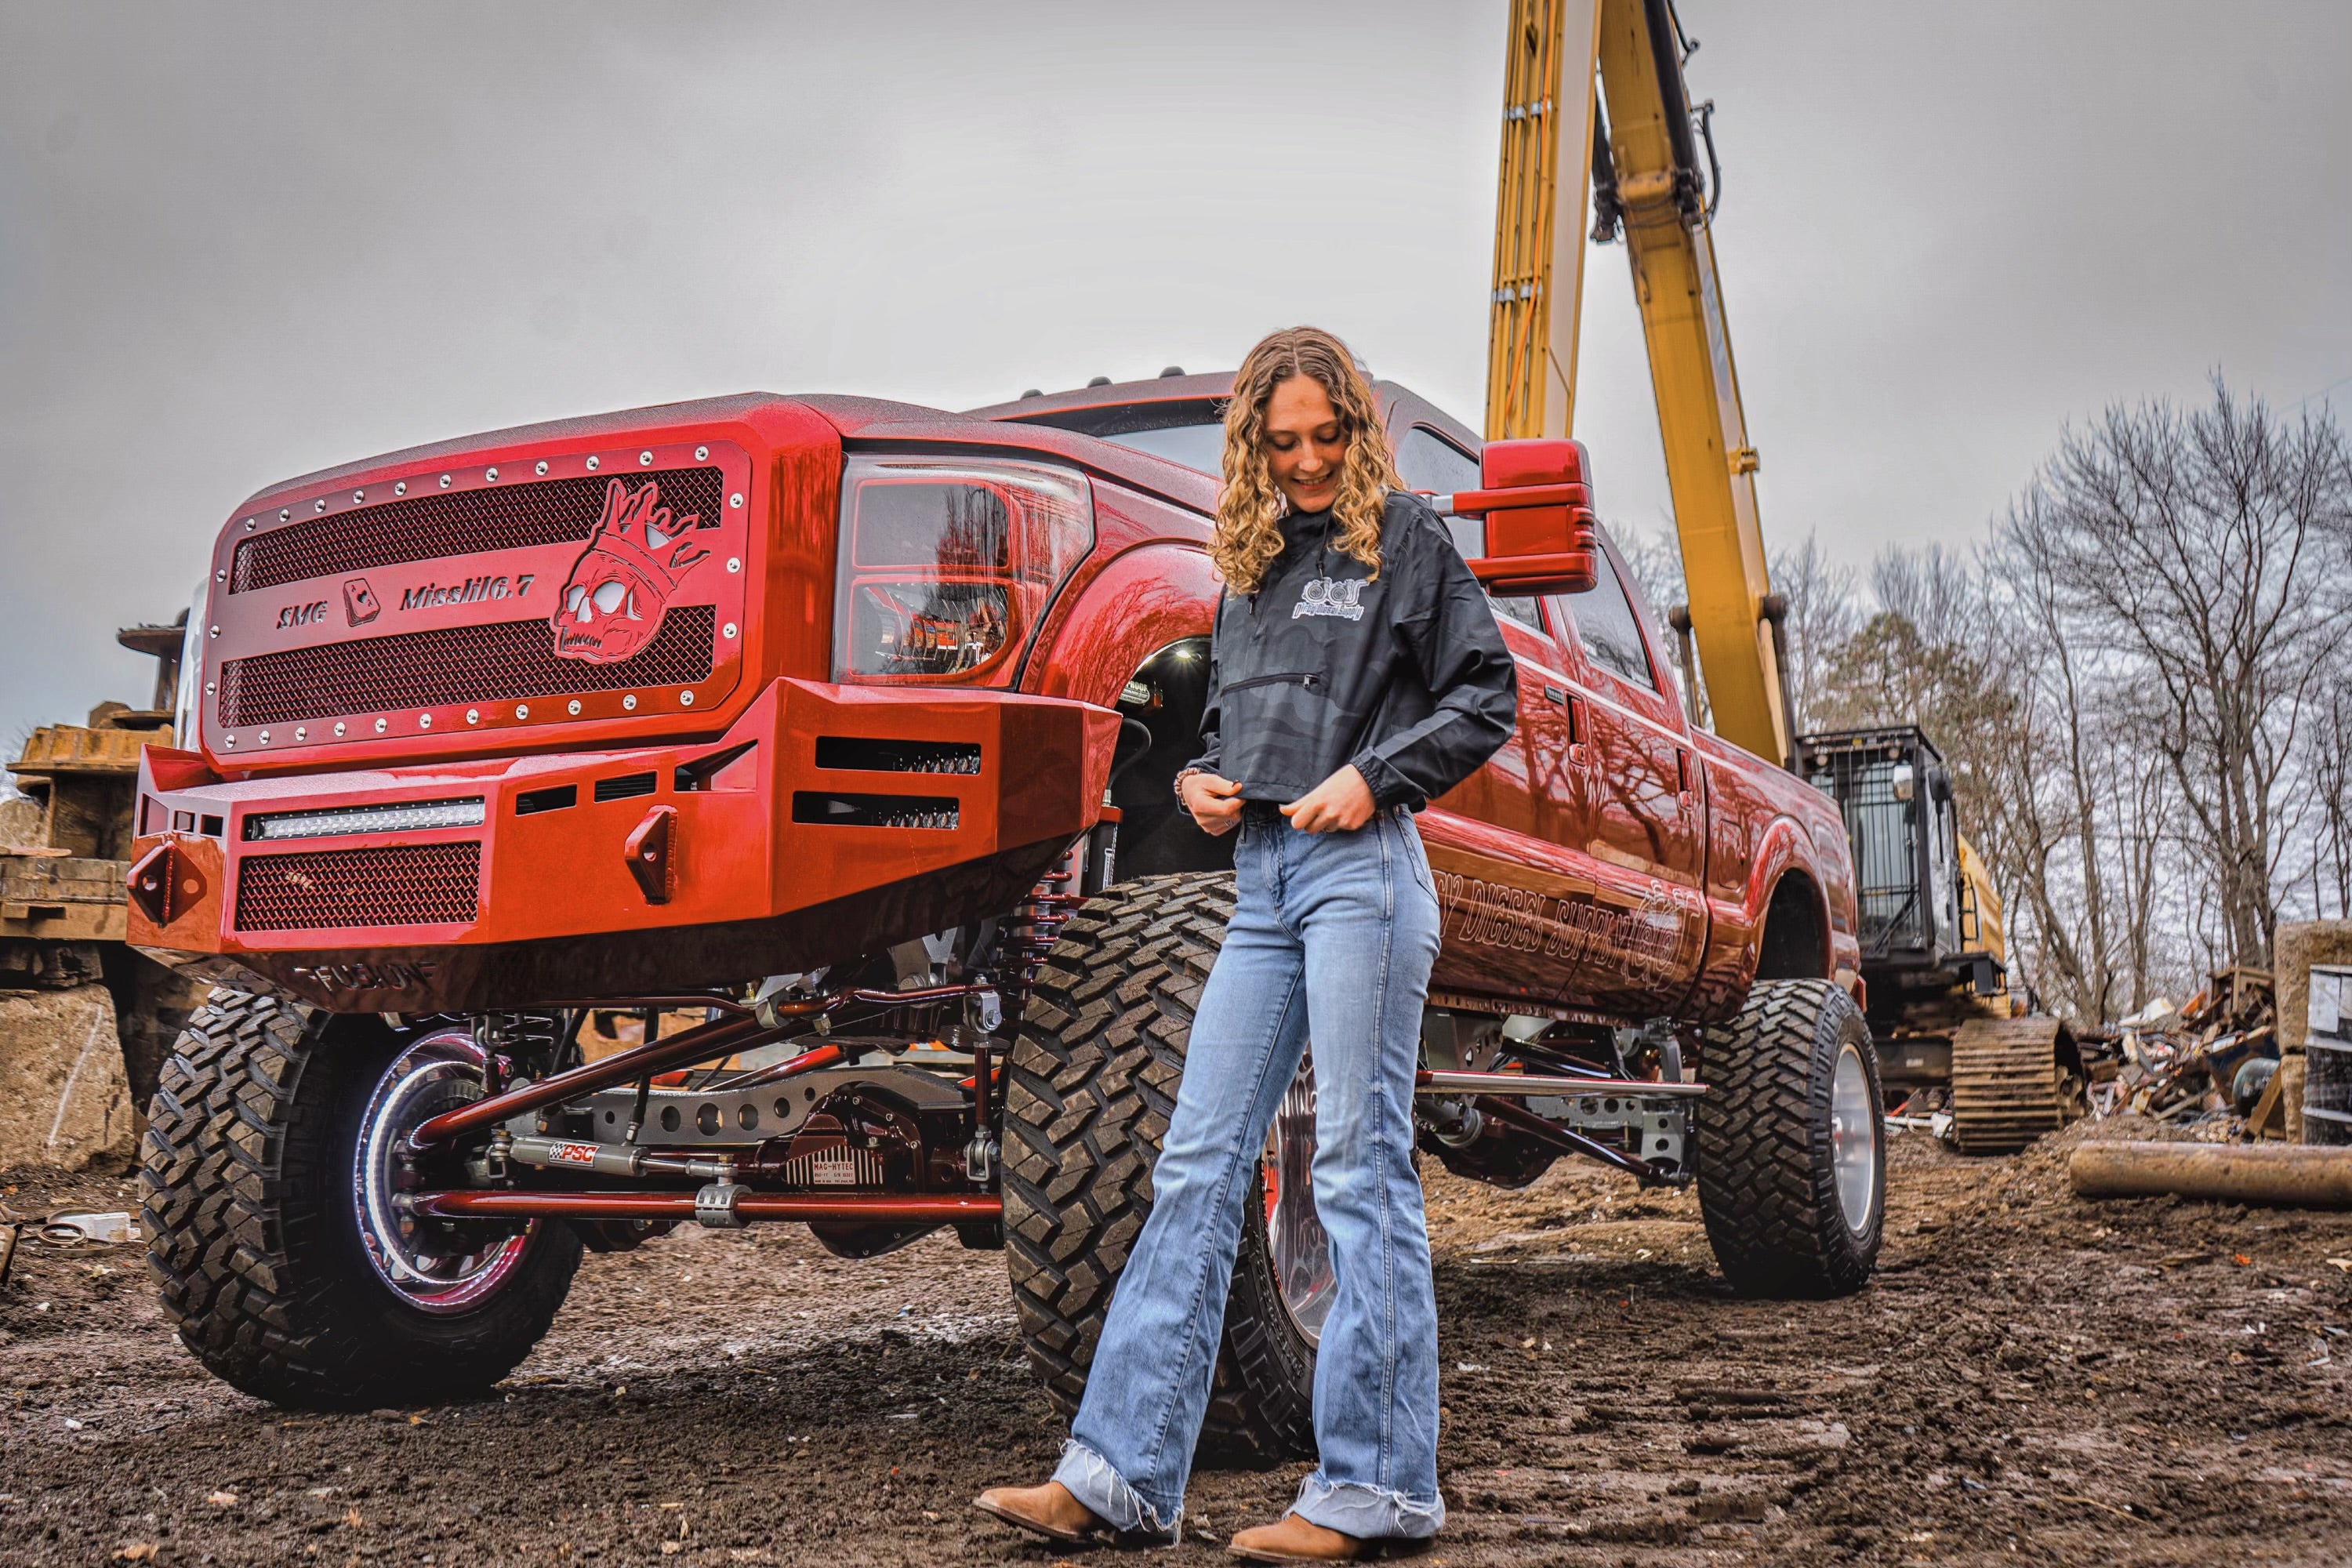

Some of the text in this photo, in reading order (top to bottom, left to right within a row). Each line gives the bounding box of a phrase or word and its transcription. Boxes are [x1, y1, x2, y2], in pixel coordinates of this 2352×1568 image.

[276, 600, 328, 630] SMG
[1458, 878, 1546, 953] DIESEL
[1544, 898, 1631, 969] SUPPLY
[561, 1144, 597, 1162] PSC
